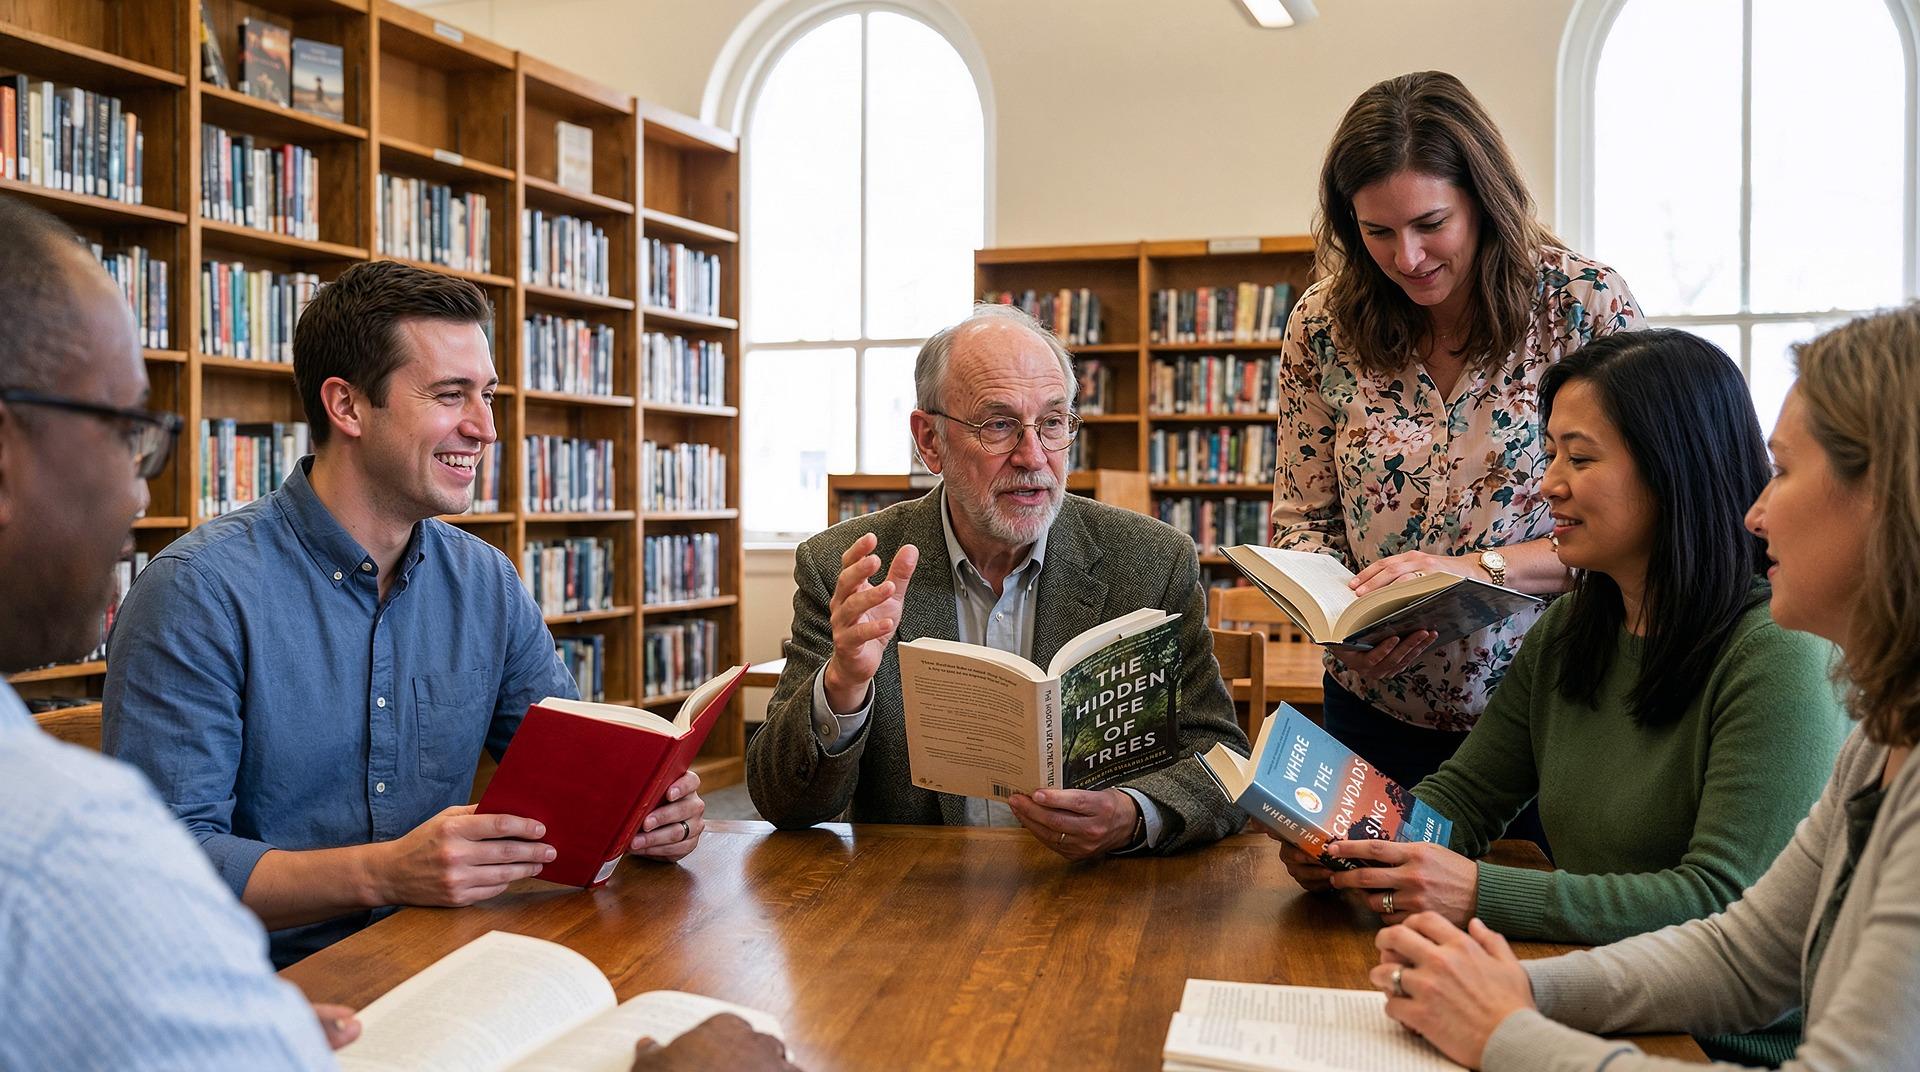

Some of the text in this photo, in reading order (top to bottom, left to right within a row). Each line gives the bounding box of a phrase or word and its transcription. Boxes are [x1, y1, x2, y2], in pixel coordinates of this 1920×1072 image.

[1096, 654, 1144, 688] THE
[1076, 668, 1165, 720] HIDDEN
[1095, 696, 1144, 728] LIFE
[1103, 719, 1137, 742] OF
[1084, 732, 1157, 769] TREES
[1283, 734, 1310, 784] WHERE
[1313, 762, 1334, 792] THE
[1333, 758, 1369, 837] CRAWDADS
[1262, 802, 1321, 846] WHERE THE
[1365, 800, 1388, 840] SING
